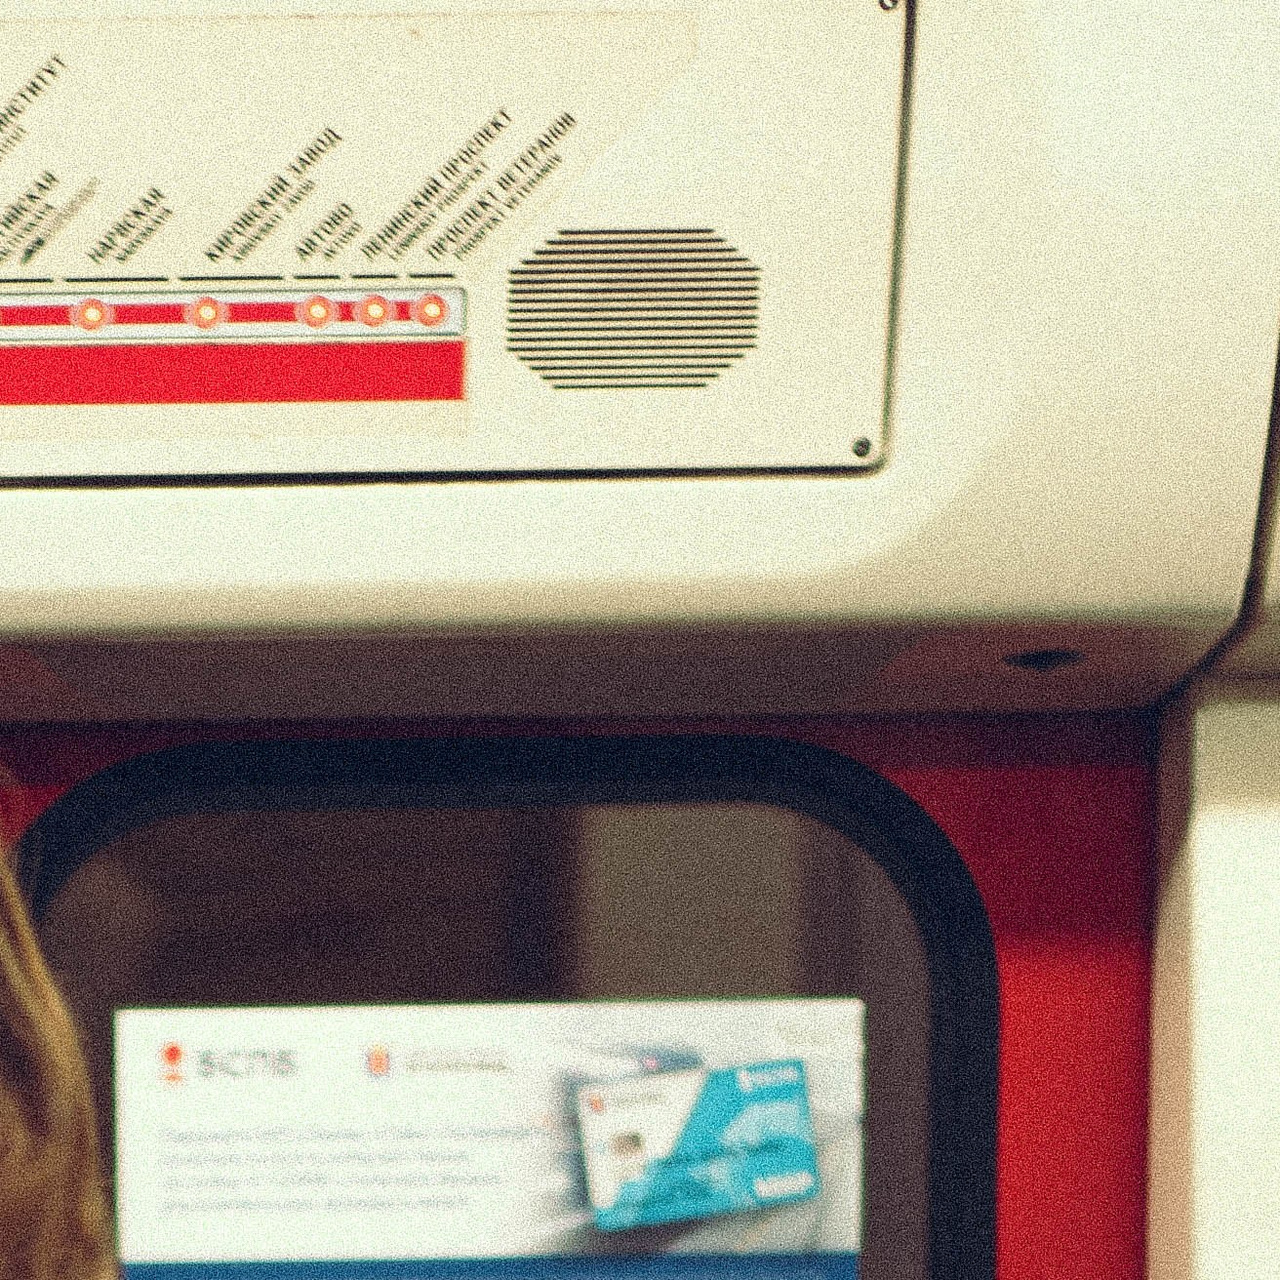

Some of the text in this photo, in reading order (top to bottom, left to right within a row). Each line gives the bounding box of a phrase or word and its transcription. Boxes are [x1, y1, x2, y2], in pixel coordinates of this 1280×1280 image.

[86, 185, 164, 264] НАРВСКАЯ
[203, 124, 342, 263] КИРОВСКИЙ ЗАВОД
[295, 202, 353, 261] АВТОВО
[360, 106, 512, 260] ЛЕНИНСКИЙ ПРОСПЕКТ
[425, 110, 576, 262] ПРОСПЕКТ ВЕТЕРАНОВ
